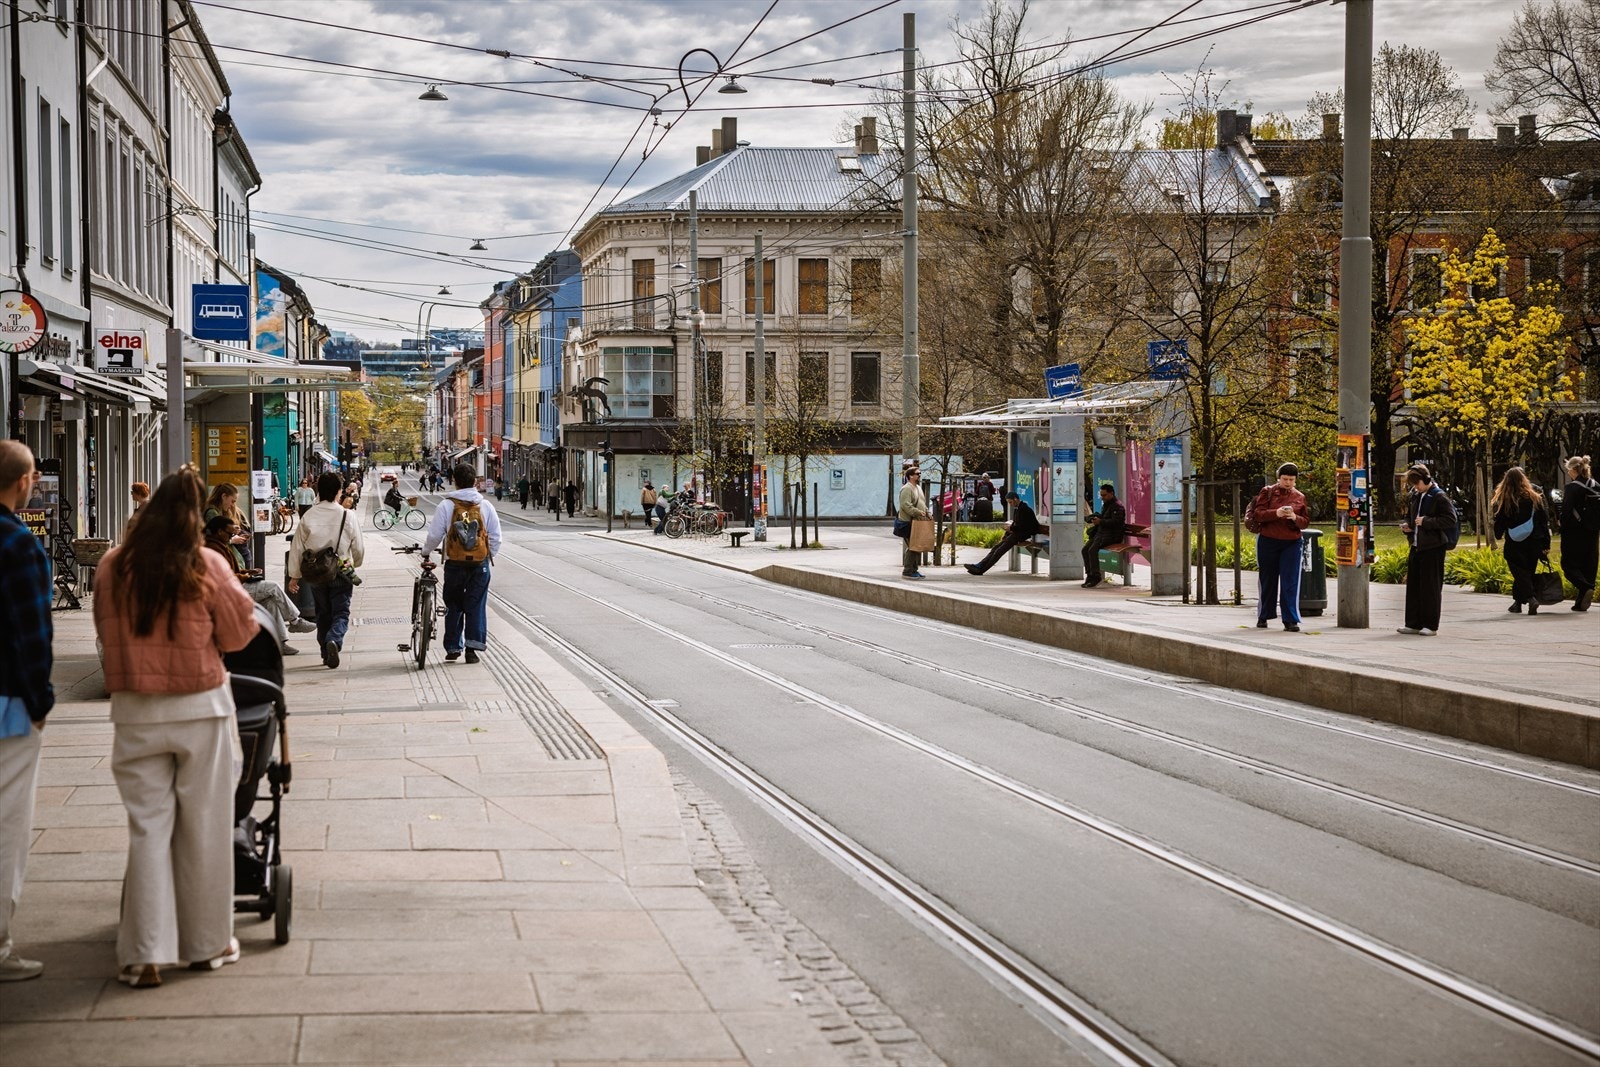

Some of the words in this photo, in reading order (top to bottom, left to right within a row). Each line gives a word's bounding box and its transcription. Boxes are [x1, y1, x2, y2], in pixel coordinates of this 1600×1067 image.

[0, 322, 30, 332] alazzo
[98, 331, 142, 349] elna
[17, 512, 46, 522] ilbud
